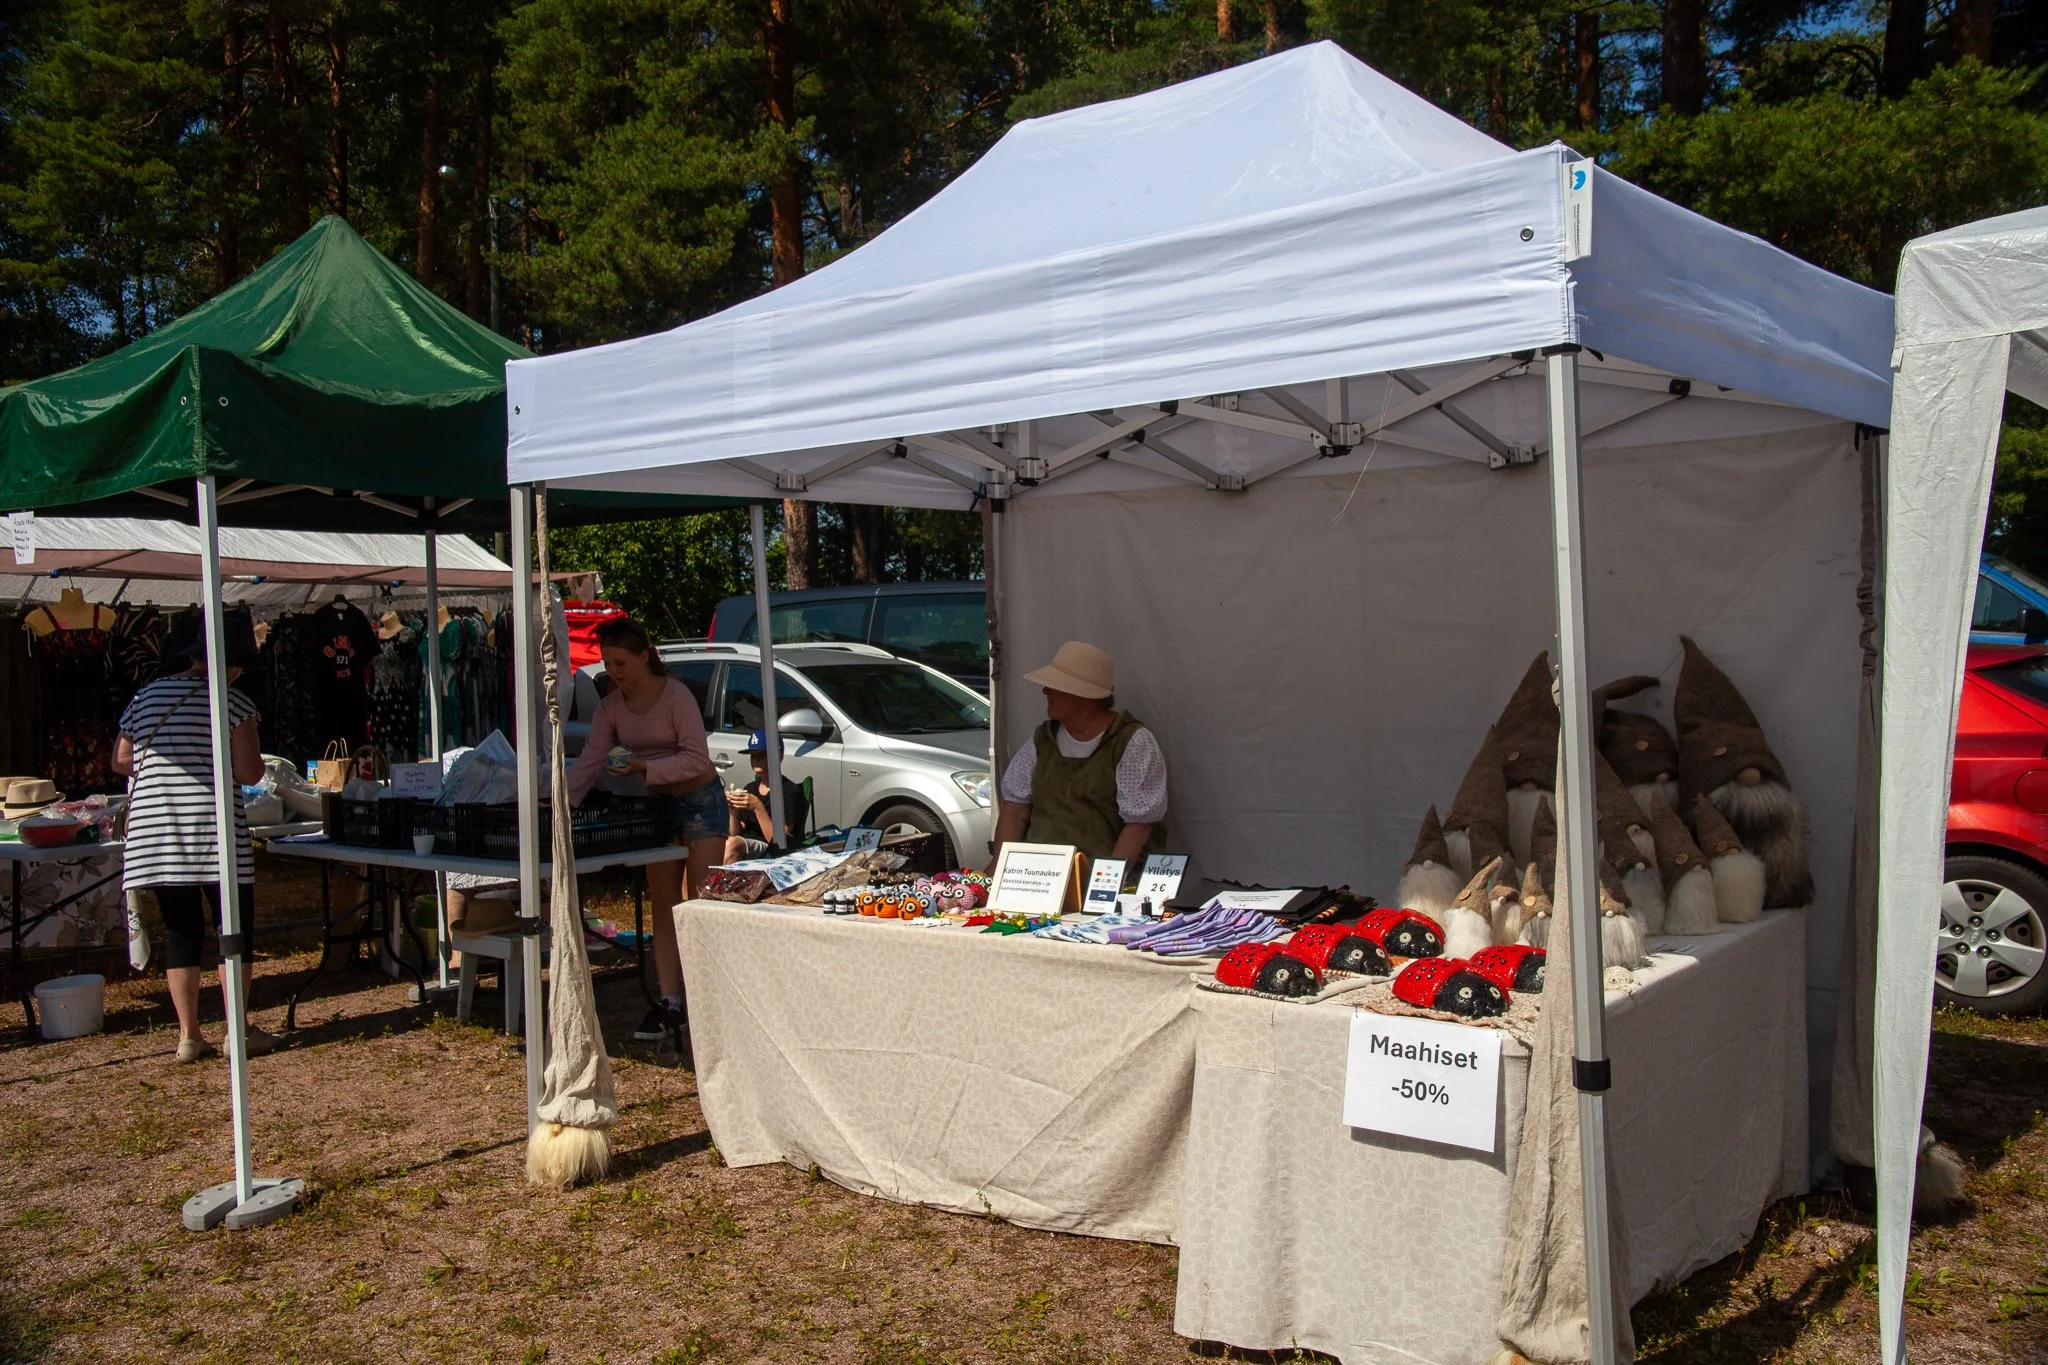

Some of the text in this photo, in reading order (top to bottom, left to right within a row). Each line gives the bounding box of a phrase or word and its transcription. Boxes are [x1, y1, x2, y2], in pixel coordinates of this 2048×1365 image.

[1148, 866, 1181, 877] Yllätys
[1150, 883, 1167, 892] 2 €
[1370, 1034, 1477, 1070] Maahiset
[1391, 1078, 1450, 1105] -50%
